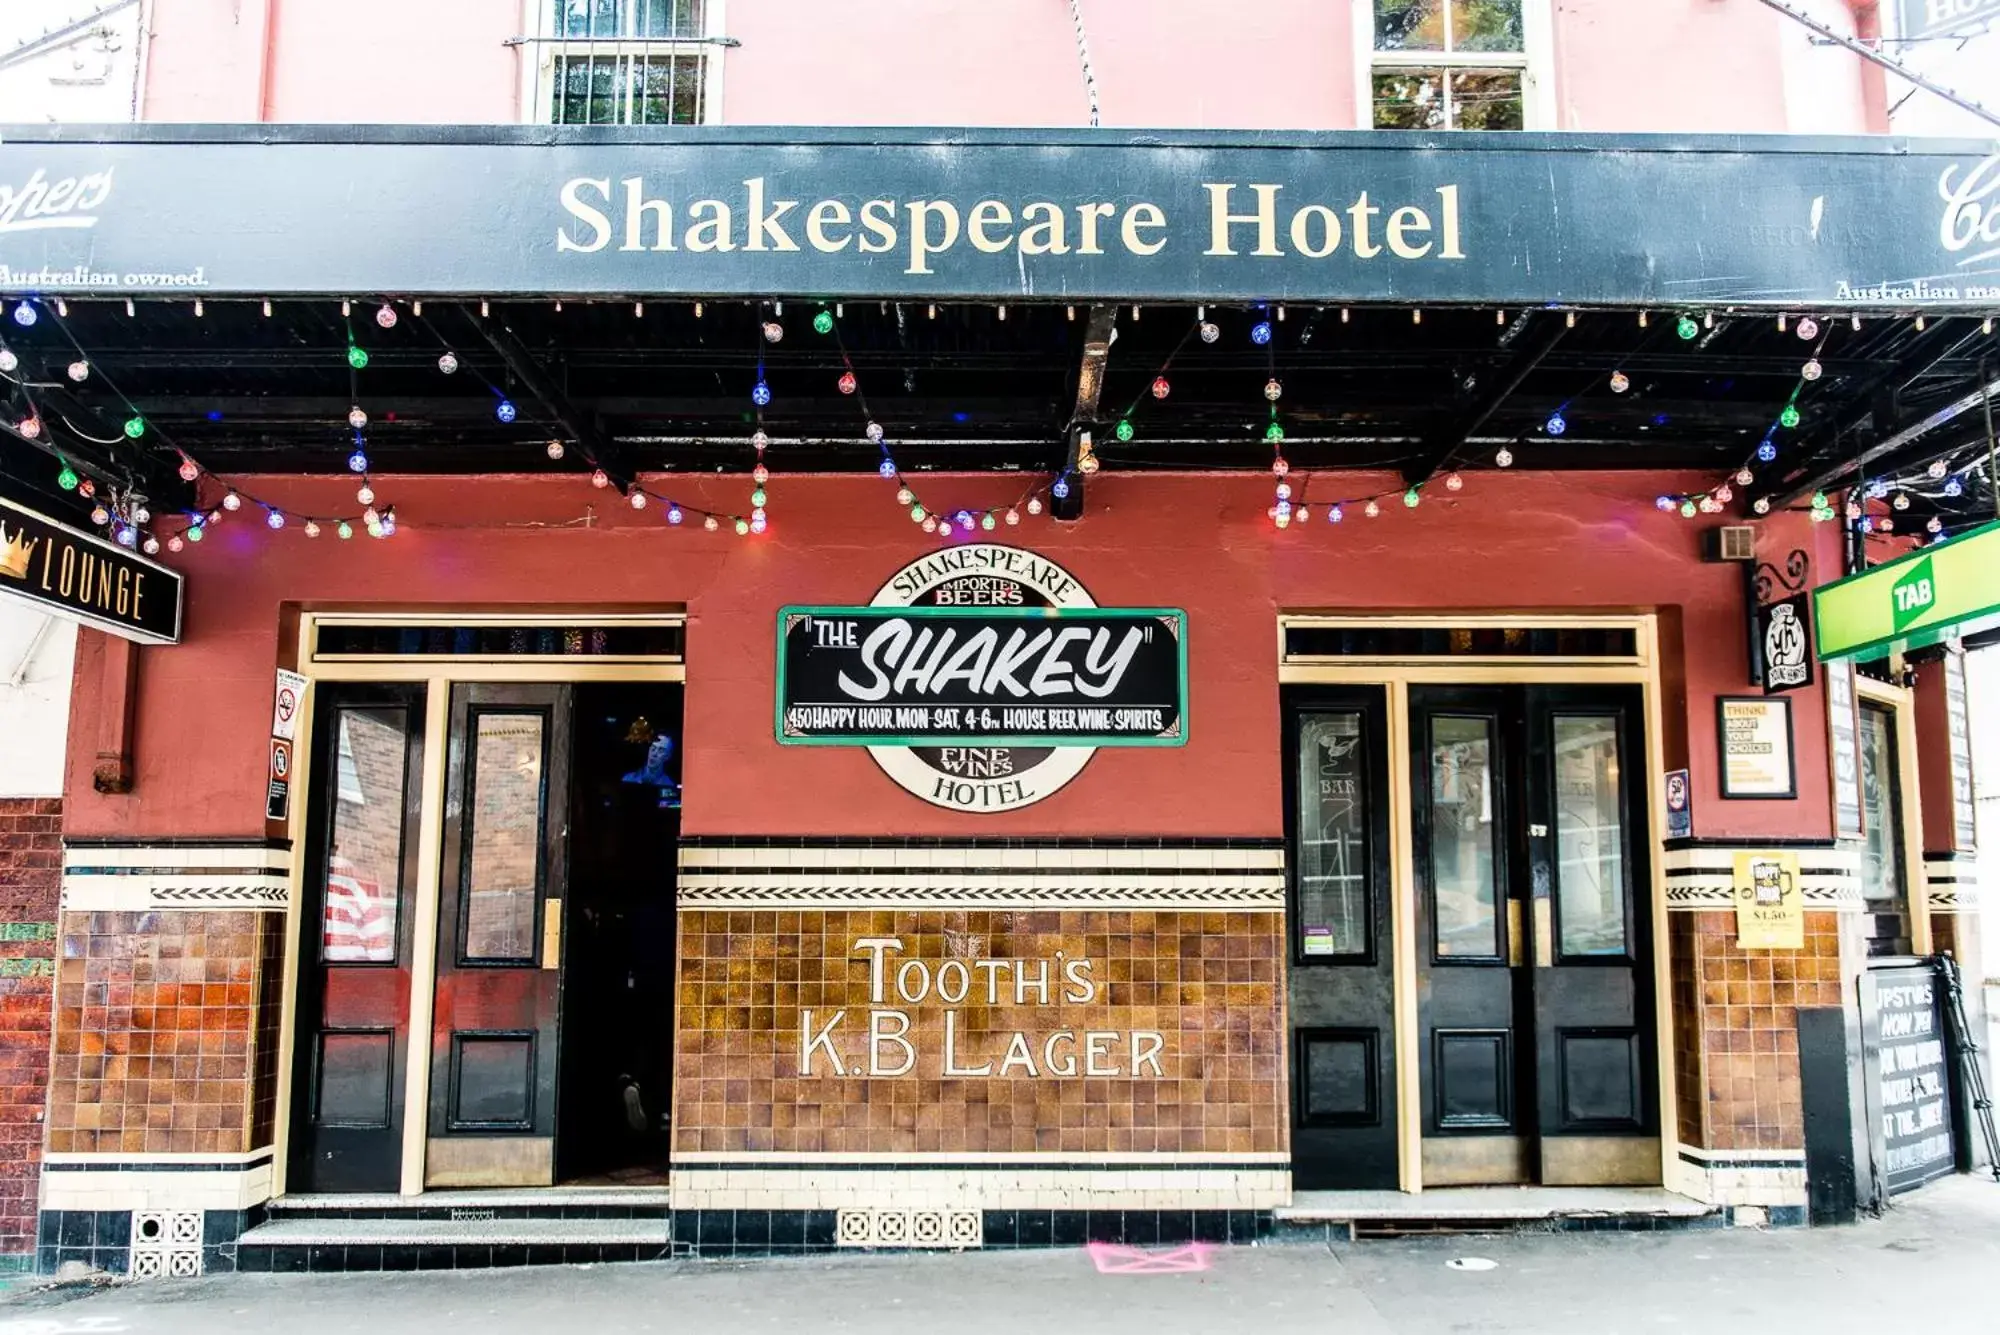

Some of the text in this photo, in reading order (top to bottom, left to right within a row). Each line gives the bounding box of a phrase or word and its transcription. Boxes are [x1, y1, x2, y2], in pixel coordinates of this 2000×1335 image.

[556, 176, 1466, 275] Shakespeare Hotel
[0, 264, 209, 286] Australian owned.
[1835, 280, 1959, 300] Australian
[42, 537, 145, 620] LOUNGE
[893, 548, 1077, 606] SHAKESPEARE
[943, 577, 1020, 590] IMPORTED
[935, 590, 1024, 605] BEERS
[1894, 578, 1933, 612] TAB
[812, 706, 856, 729] HAPPY
[1003, 707, 1047, 730] HOUSE
[940, 748, 1011, 761] FINE
[942, 761, 1014, 776] WINES
[933, 776, 1036, 807] HOTEL
[1320, 780, 1355, 794] BAR
[942, 1009, 1165, 1077] LAGER
